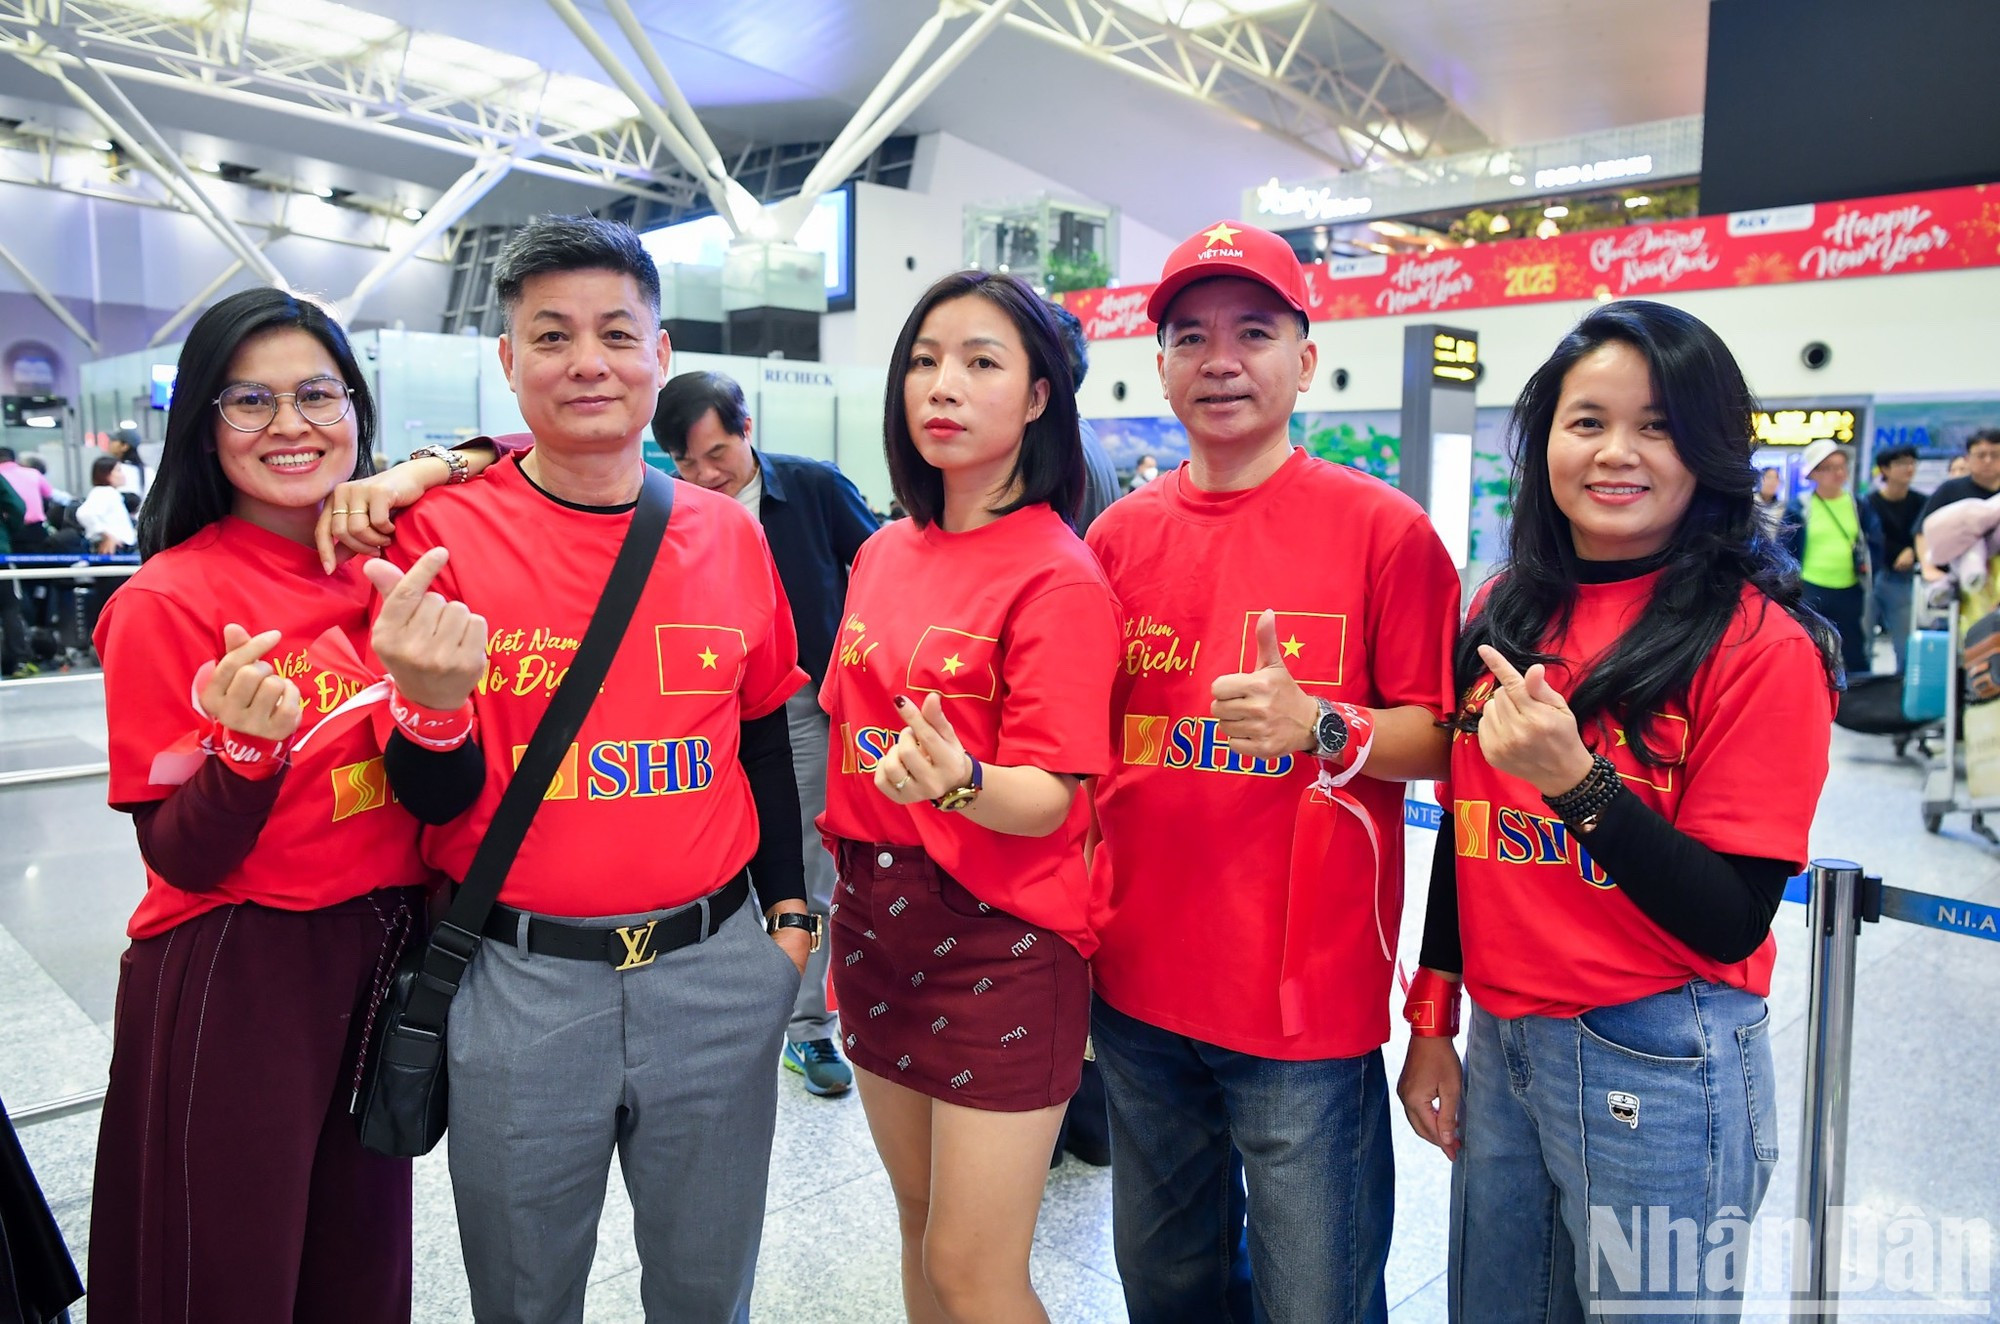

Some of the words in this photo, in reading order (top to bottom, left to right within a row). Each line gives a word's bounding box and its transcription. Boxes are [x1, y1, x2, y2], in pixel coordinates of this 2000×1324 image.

[1823, 205, 1932, 248] Happy
[1220, 248, 1243, 258] NAM
[1505, 264, 1557, 297] 2025
[765, 369, 833, 386] RECHECK
[1134, 615, 1175, 637] Nam
[528, 627, 581, 651] Nam
[588, 736, 714, 800] SHB
